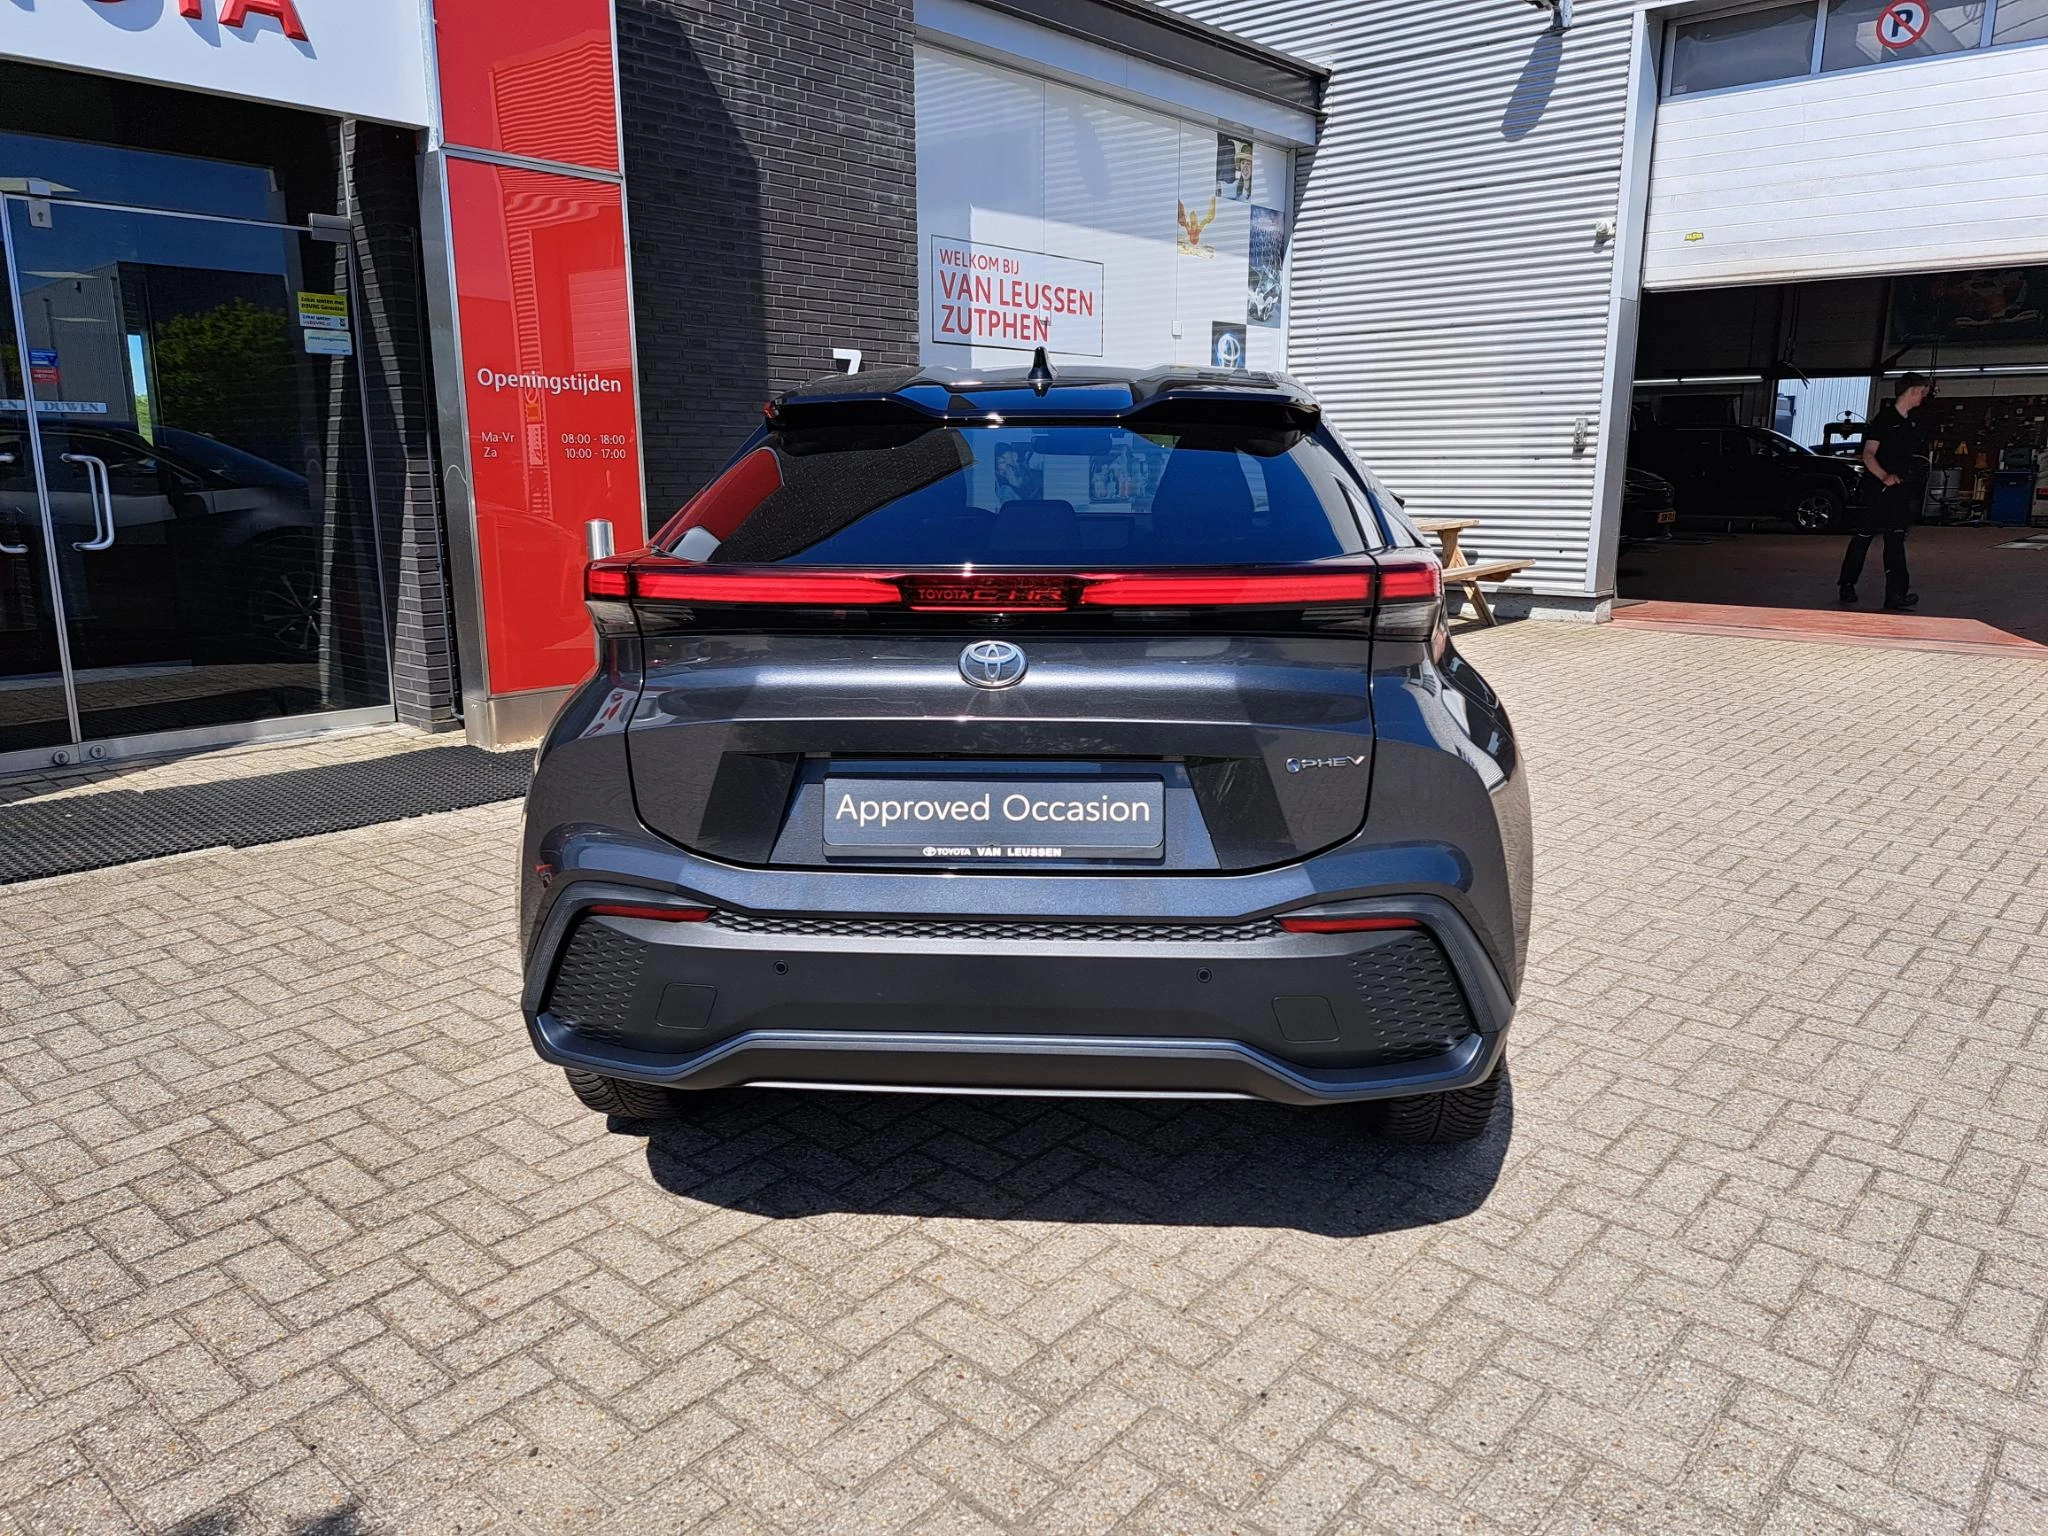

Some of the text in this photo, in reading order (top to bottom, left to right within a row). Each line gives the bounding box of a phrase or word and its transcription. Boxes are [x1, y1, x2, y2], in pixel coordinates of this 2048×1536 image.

[940, 248, 1019, 275] WELKOM BIJ
[940, 270, 1093, 317] VAN LEUSSEN
[941, 304, 1049, 342] ZUTPHEN
[833, 348, 861, 375] 7
[477, 368, 621, 395] Openingstijden
[481, 432, 515, 443] Ma-Vr
[561, 433, 591, 444] 08:00
[600, 434, 625, 445] 18:00
[483, 447, 497, 458] Za
[565, 448, 591, 459] 10:00
[601, 448, 626, 459] 17:00
[918, 589, 970, 600] TOYOTA
[1301, 755, 1366, 769] PHEV
[835, 793, 1150, 827] Approved Occasion
[937, 847, 1062, 858] TOYOTA VAN LEUSSEN
